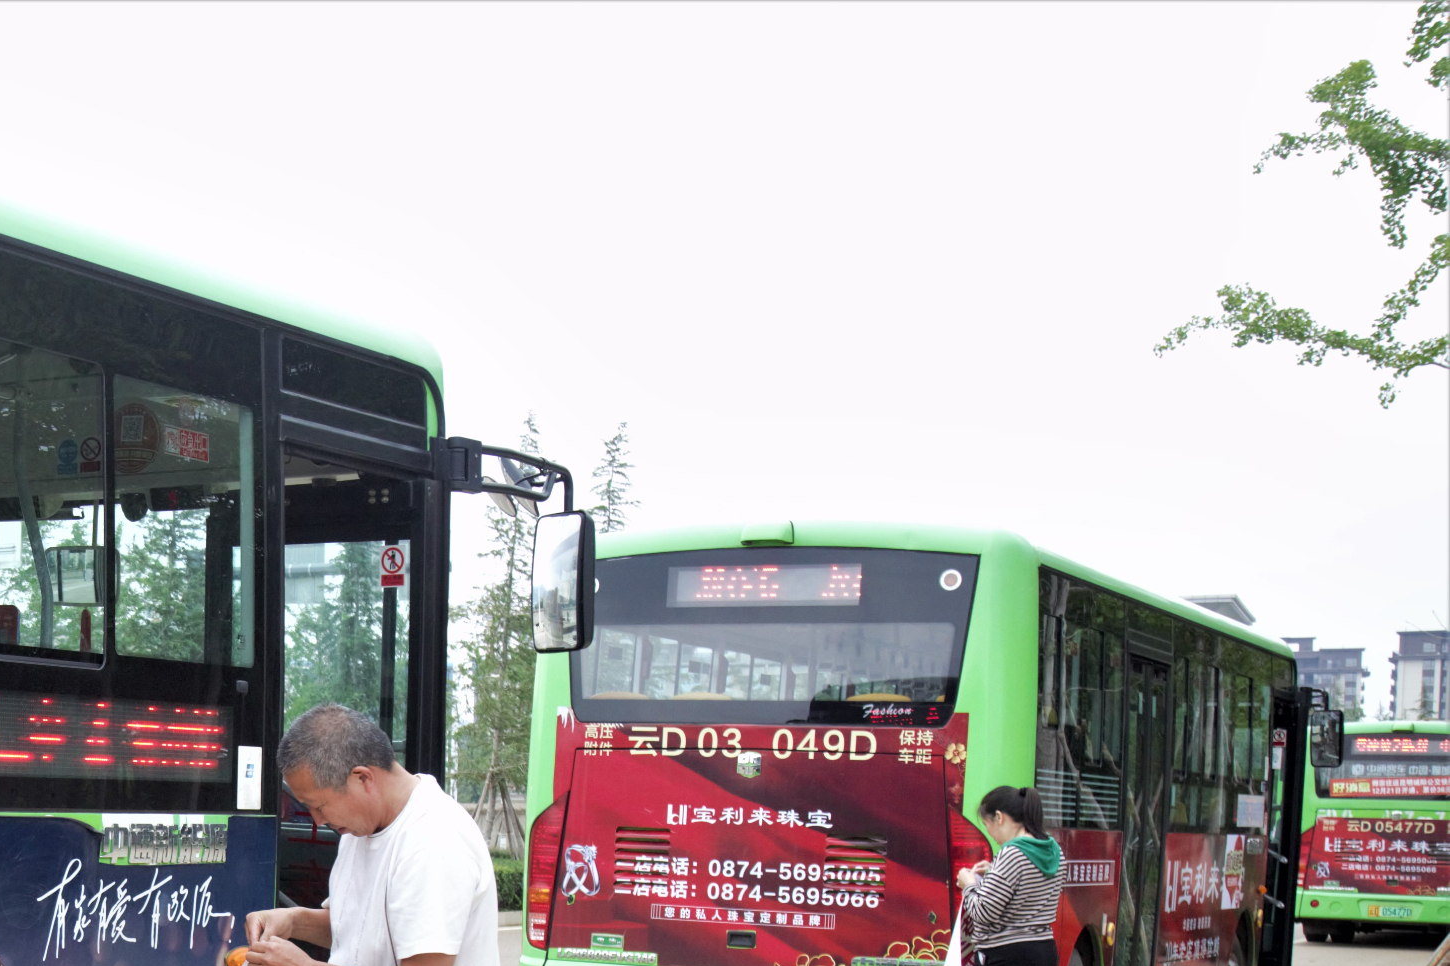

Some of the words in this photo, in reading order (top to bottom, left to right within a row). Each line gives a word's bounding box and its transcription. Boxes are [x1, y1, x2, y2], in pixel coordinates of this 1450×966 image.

[772, 728, 878, 761] 049D
[899, 728, 934, 747] 保持
[897, 747, 933, 765] 车距
[691, 805, 834, 829] 宝利来珠宝
[1375, 820, 1436, 834] 05477D
[100, 823, 229, 865] 中通新能源
[664, 906, 821, 927] 您的私人珠宝定制品牌
